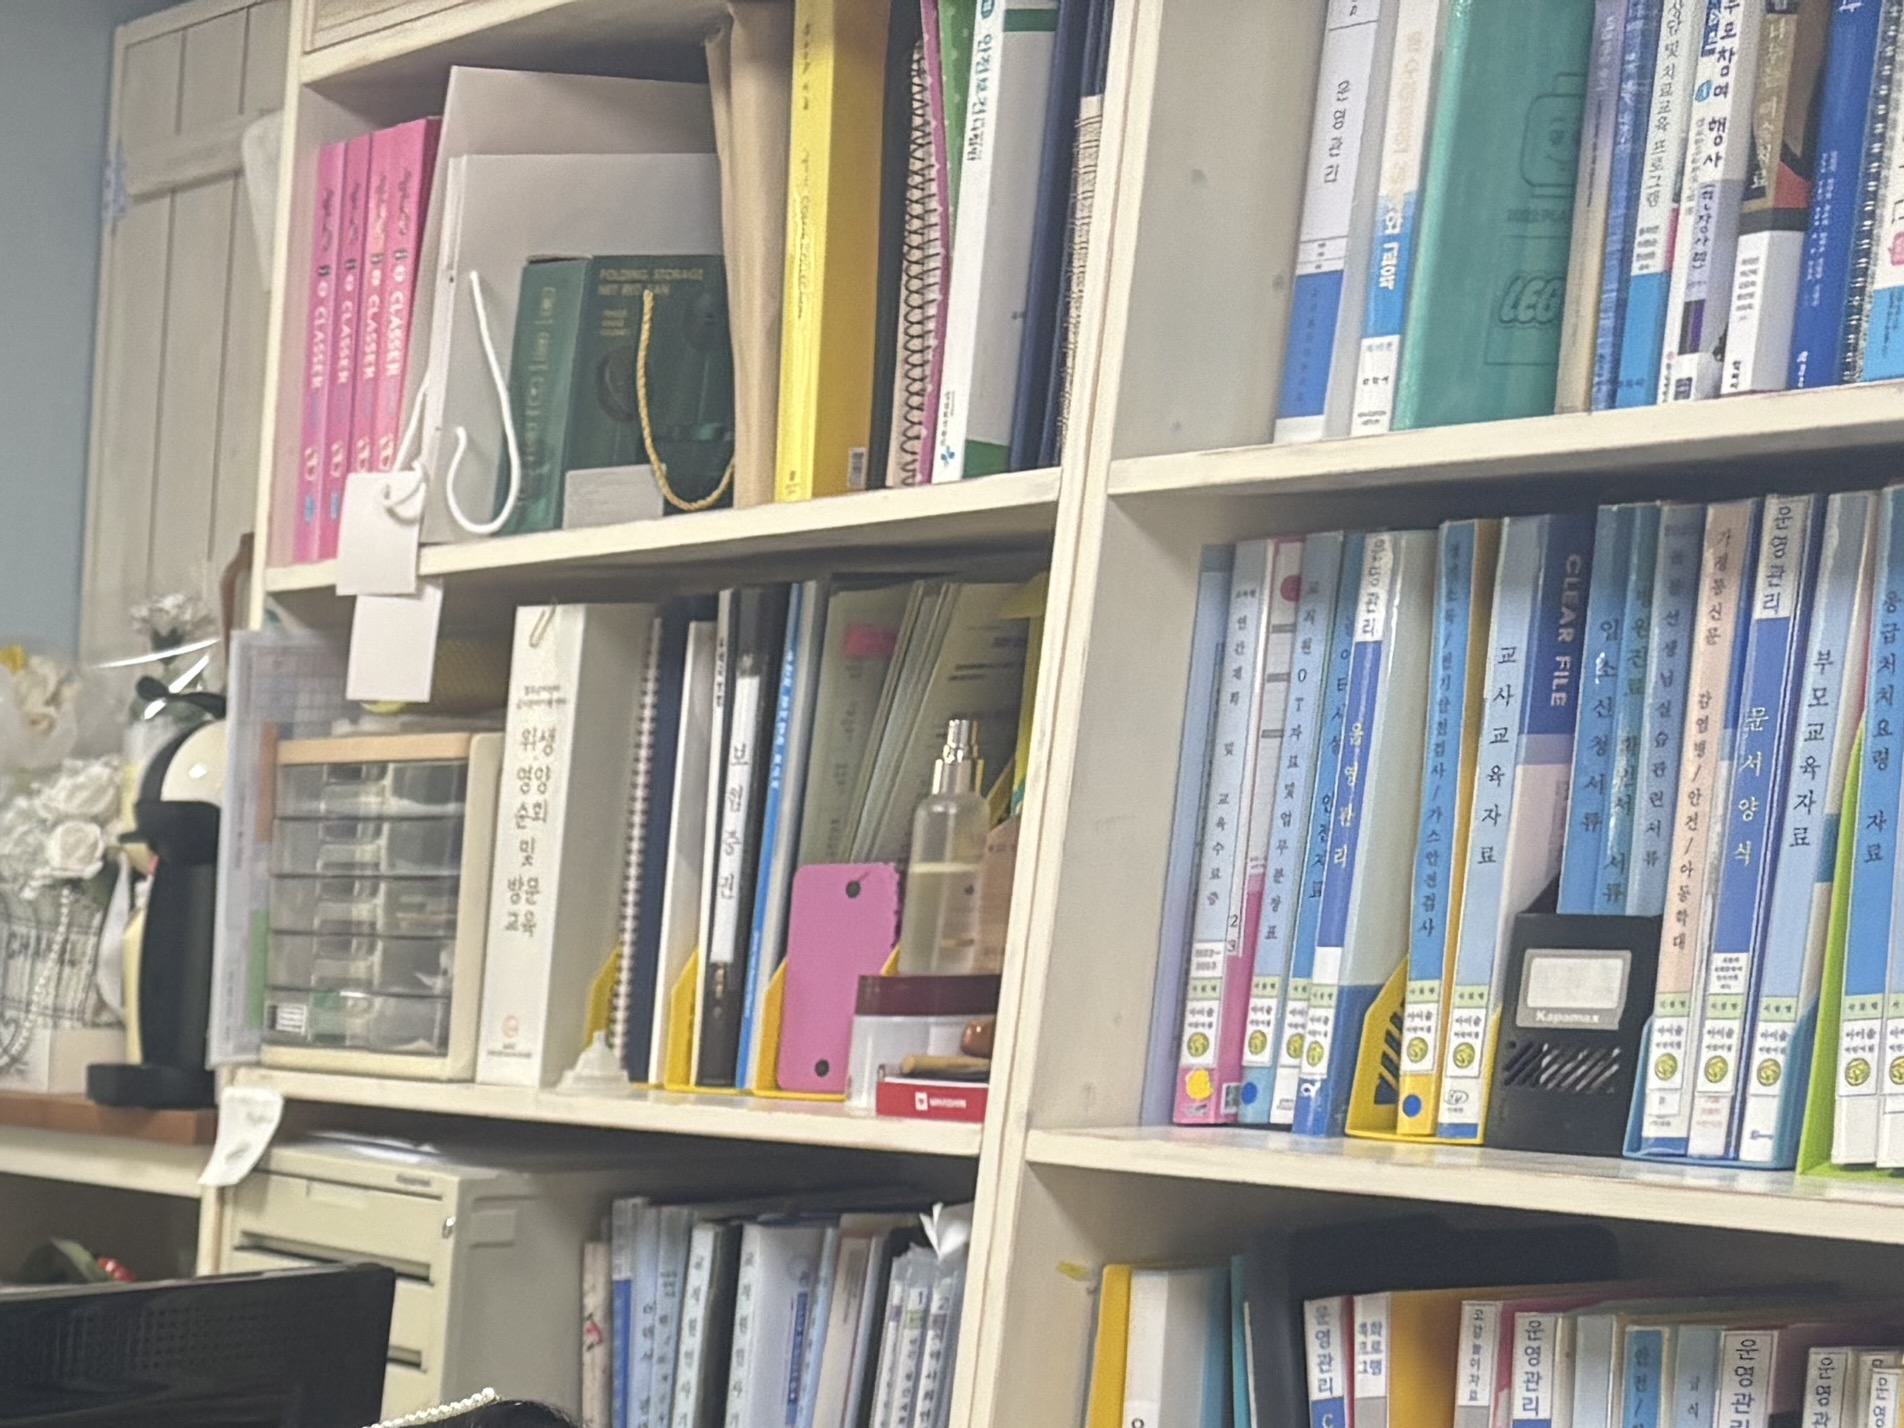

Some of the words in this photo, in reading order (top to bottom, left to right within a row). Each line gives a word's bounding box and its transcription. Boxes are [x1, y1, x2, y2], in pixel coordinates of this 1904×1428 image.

[1324, 79, 1350, 184] 운영관리
[1703, 116, 1728, 168] 행사
[1499, 271, 1563, 330] LEG
[1557, 553, 1583, 643] CLEAR
[1762, 504, 1793, 615] 운영관리
[1550, 654, 1571, 708] FILE
[516, 764, 552, 795] 영양
[521, 726, 556, 757] 위생
[1477, 646, 1517, 864] 교사교육자료
[1735, 706, 1769, 866] 문서양식
[1789, 650, 1834, 848] 부모교육자료
[1864, 811, 1889, 864] 자료
[1312, 1304, 1336, 1397] 운영관리
[1521, 1320, 1545, 1417] 운영관리
